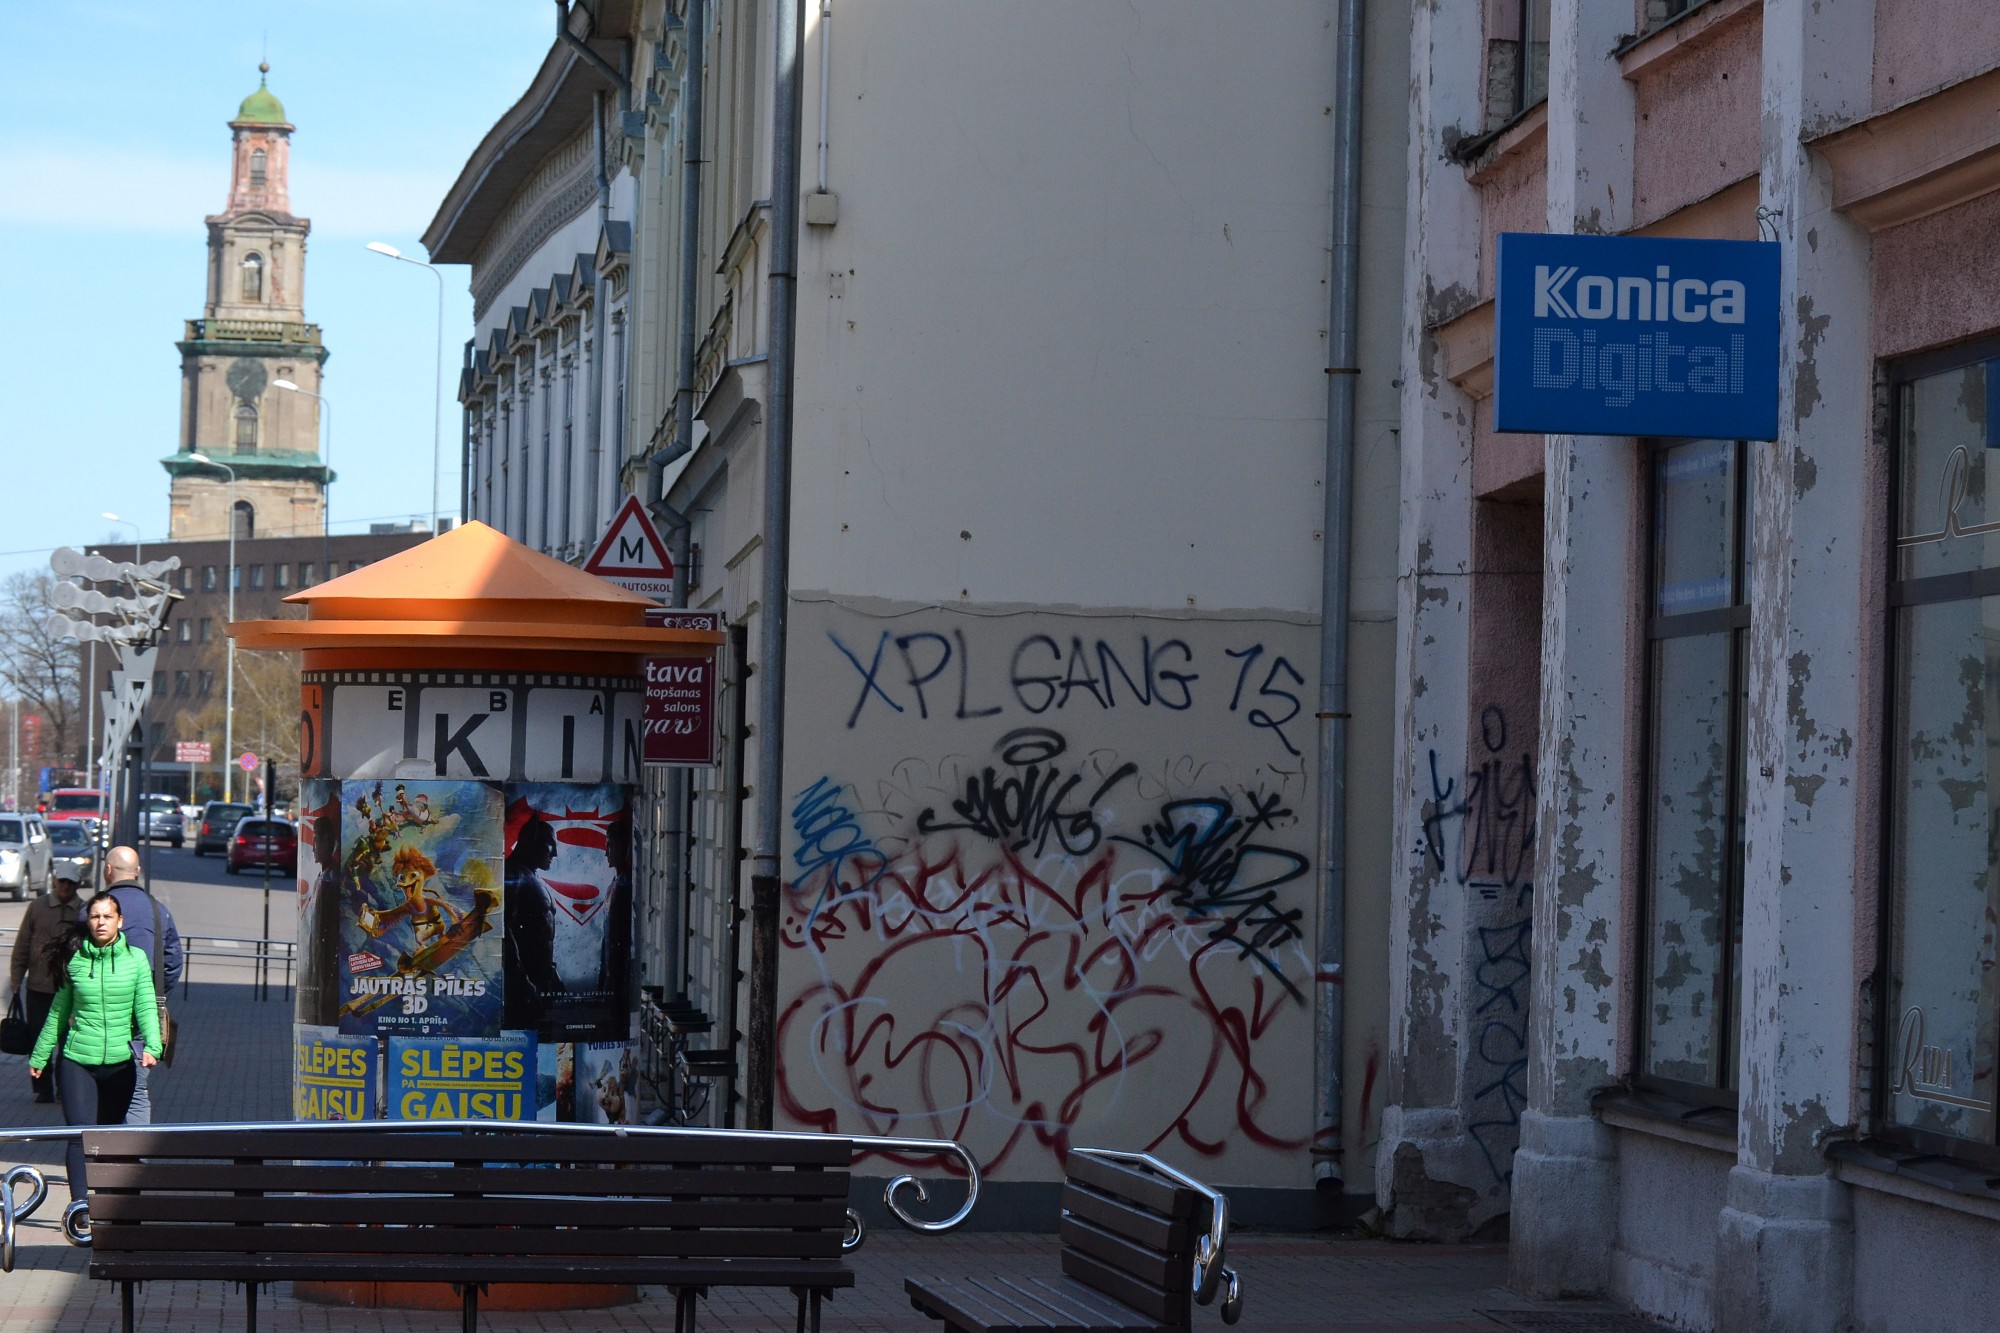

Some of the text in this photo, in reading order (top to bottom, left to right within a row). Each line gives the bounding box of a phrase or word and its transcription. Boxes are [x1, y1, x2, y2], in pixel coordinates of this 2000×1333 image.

[1534, 264, 1746, 324] Konica
[1533, 327, 1745, 407] Digital
[619, 535, 644, 564] M
[646, 661, 703, 683] tava
[490, 692, 507, 711] B
[646, 686, 701, 700] kopšanas
[589, 695, 604, 715] A
[664, 701, 701, 713] salons
[350, 973, 486, 997] JAUTRĀS PĪLES
[402, 996, 428, 1015] 3D
[378, 1016, 397, 1024] KINO
[398, 1016, 410, 1024] NO
[419, 1016, 448, 1027] APRĪĻA
[299, 1041, 367, 1077] SLĒPES
[401, 1044, 524, 1079] SLĒPES
[402, 1079, 415, 1088] PA
[299, 1086, 365, 1120] GAISU
[401, 1091, 521, 1120] GAISU
